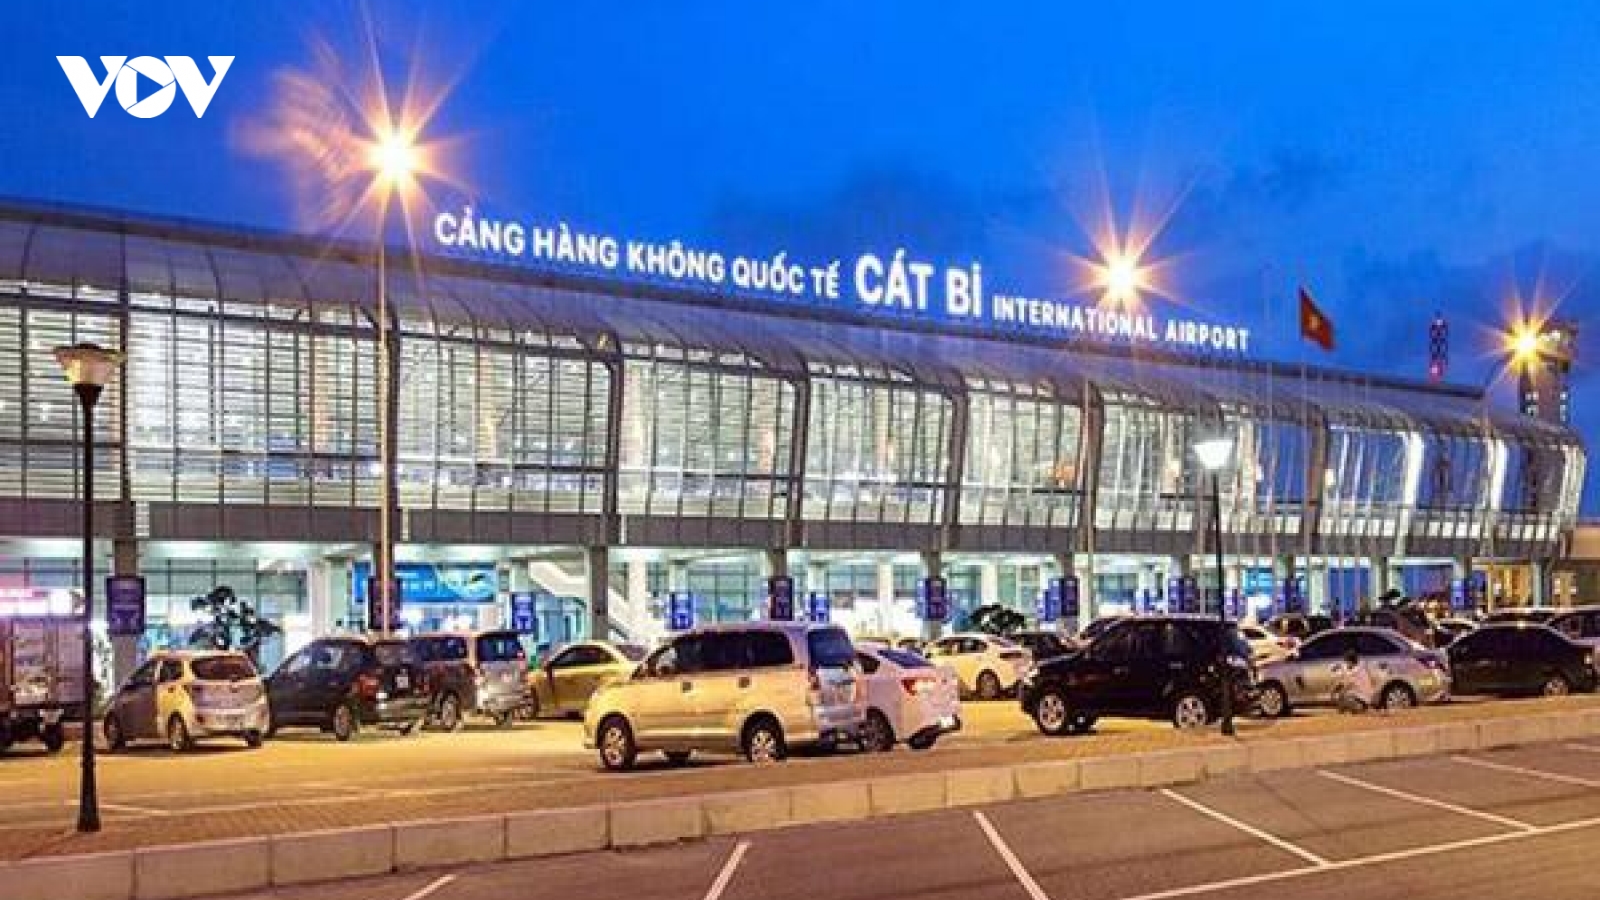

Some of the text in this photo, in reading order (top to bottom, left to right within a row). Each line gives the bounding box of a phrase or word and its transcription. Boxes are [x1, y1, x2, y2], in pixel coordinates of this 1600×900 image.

[434, 206, 525, 255] CẢNG
[532, 221, 619, 269] HÀNG
[626, 239, 726, 284] KHÔNG
[855, 247, 934, 310] CÁT
[991, 295, 1158, 342] INTERNATIONAL
[1165, 318, 1250, 352] AIRPORT
